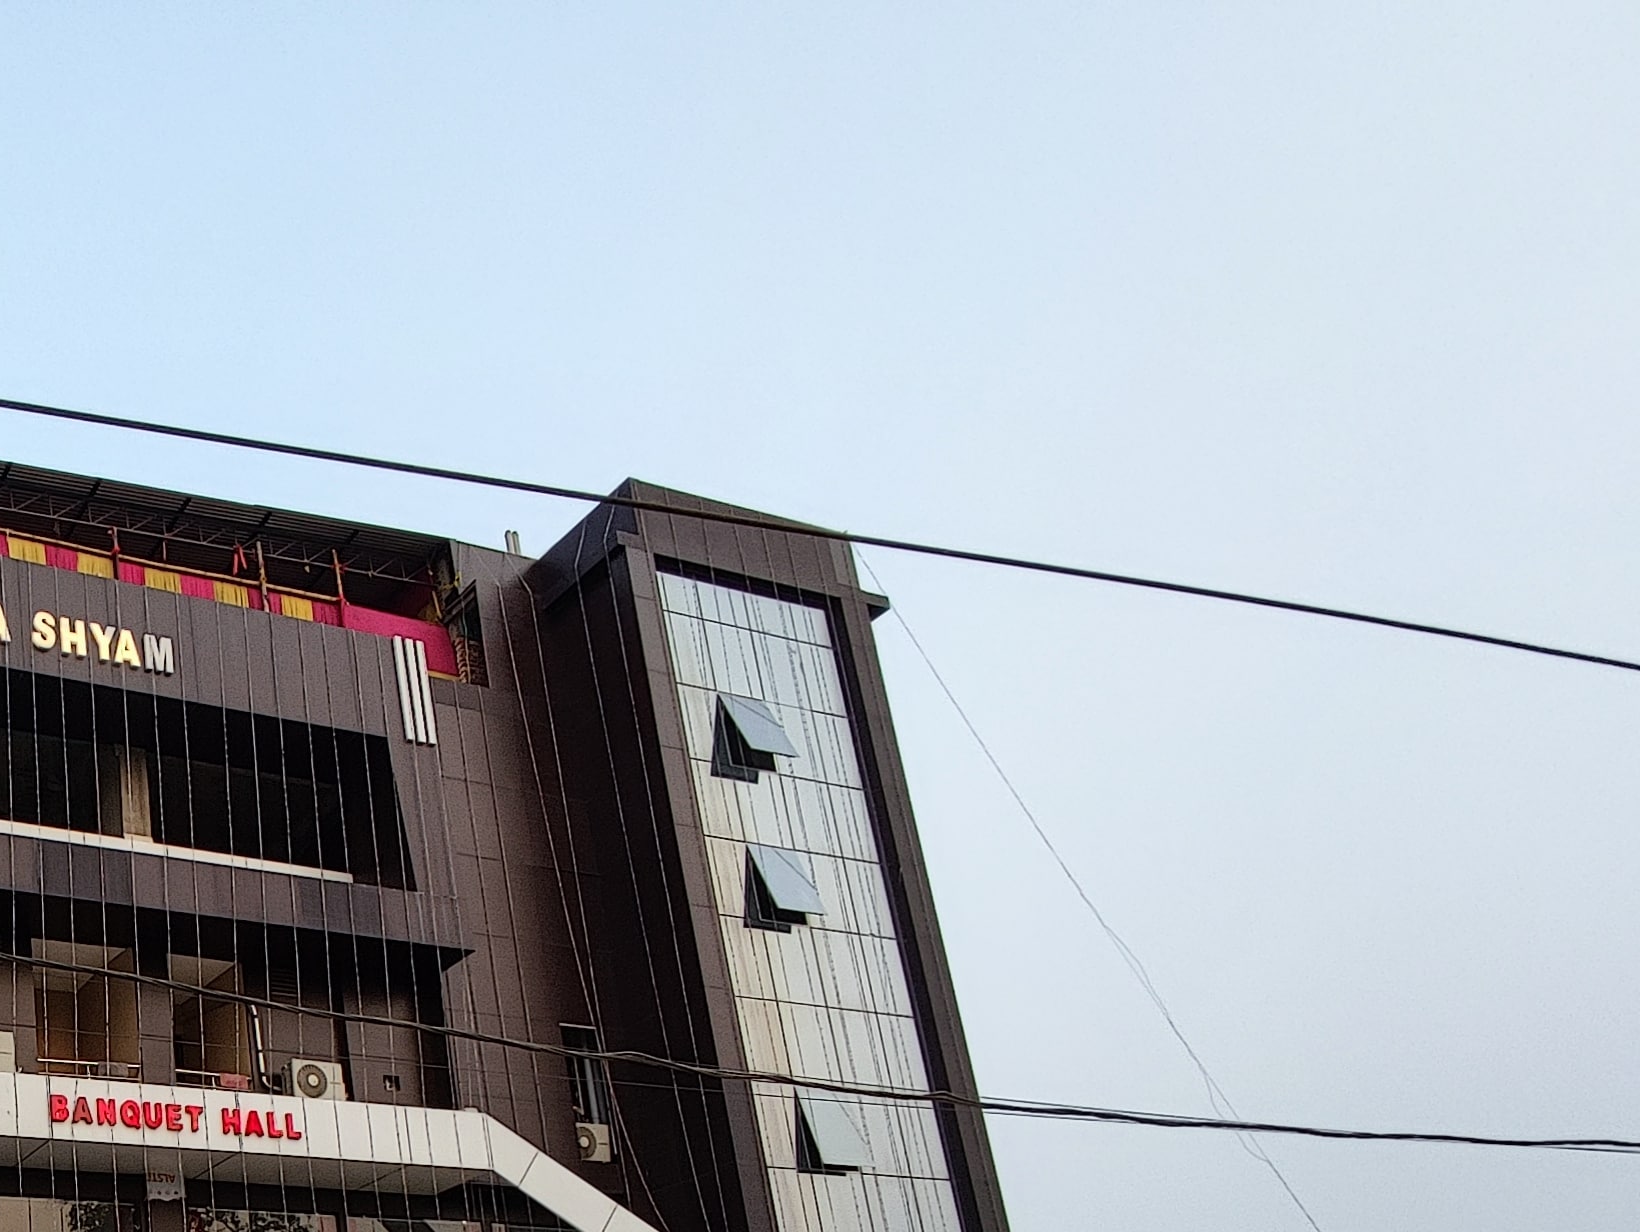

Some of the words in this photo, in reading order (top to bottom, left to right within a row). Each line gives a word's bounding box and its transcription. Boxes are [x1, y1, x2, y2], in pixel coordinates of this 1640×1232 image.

[31, 610, 175, 676] SHYAM
[50, 1094, 204, 1133] BANQUET
[221, 1108, 302, 1140] HALL
